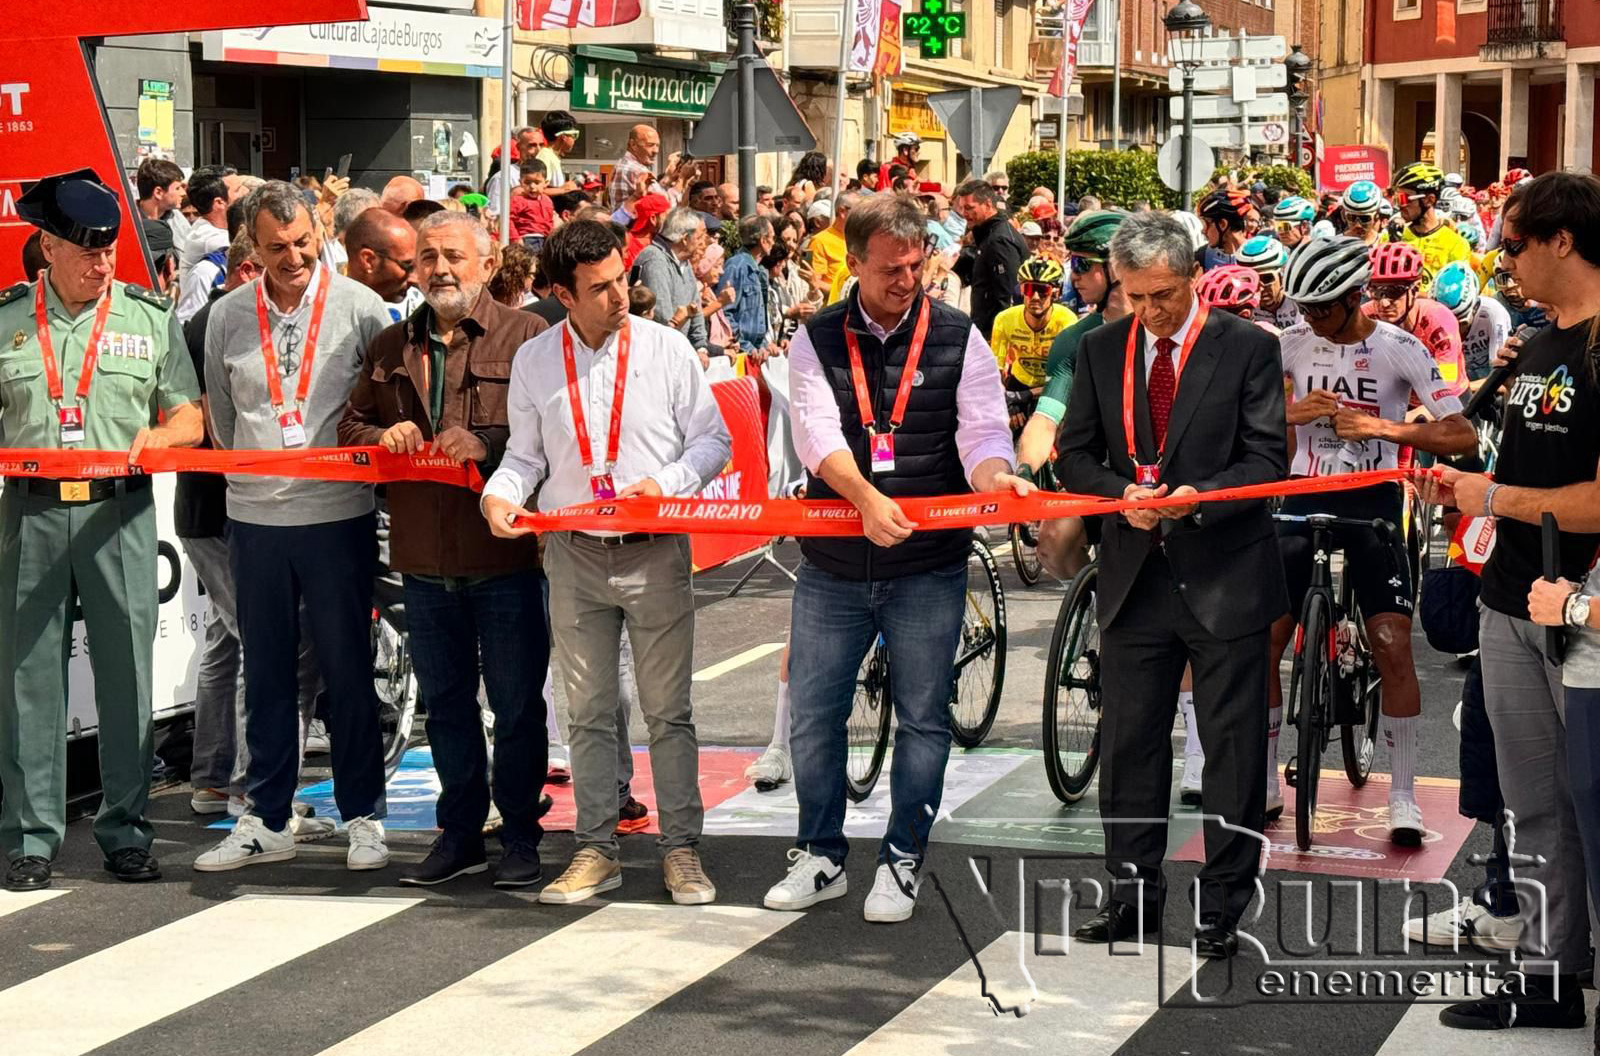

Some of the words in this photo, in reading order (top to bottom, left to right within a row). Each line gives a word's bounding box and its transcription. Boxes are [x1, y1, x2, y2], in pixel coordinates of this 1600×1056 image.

[355, 452, 367, 463] 24
[415, 458, 428, 467] LA
[657, 503, 763, 520] VILLARCAYO
[807, 509, 822, 518] LA
[822, 509, 858, 519] VUELTA
[929, 508, 942, 517] LA
[942, 506, 978, 517] VUELTA
[983, 504, 996, 513] 24
